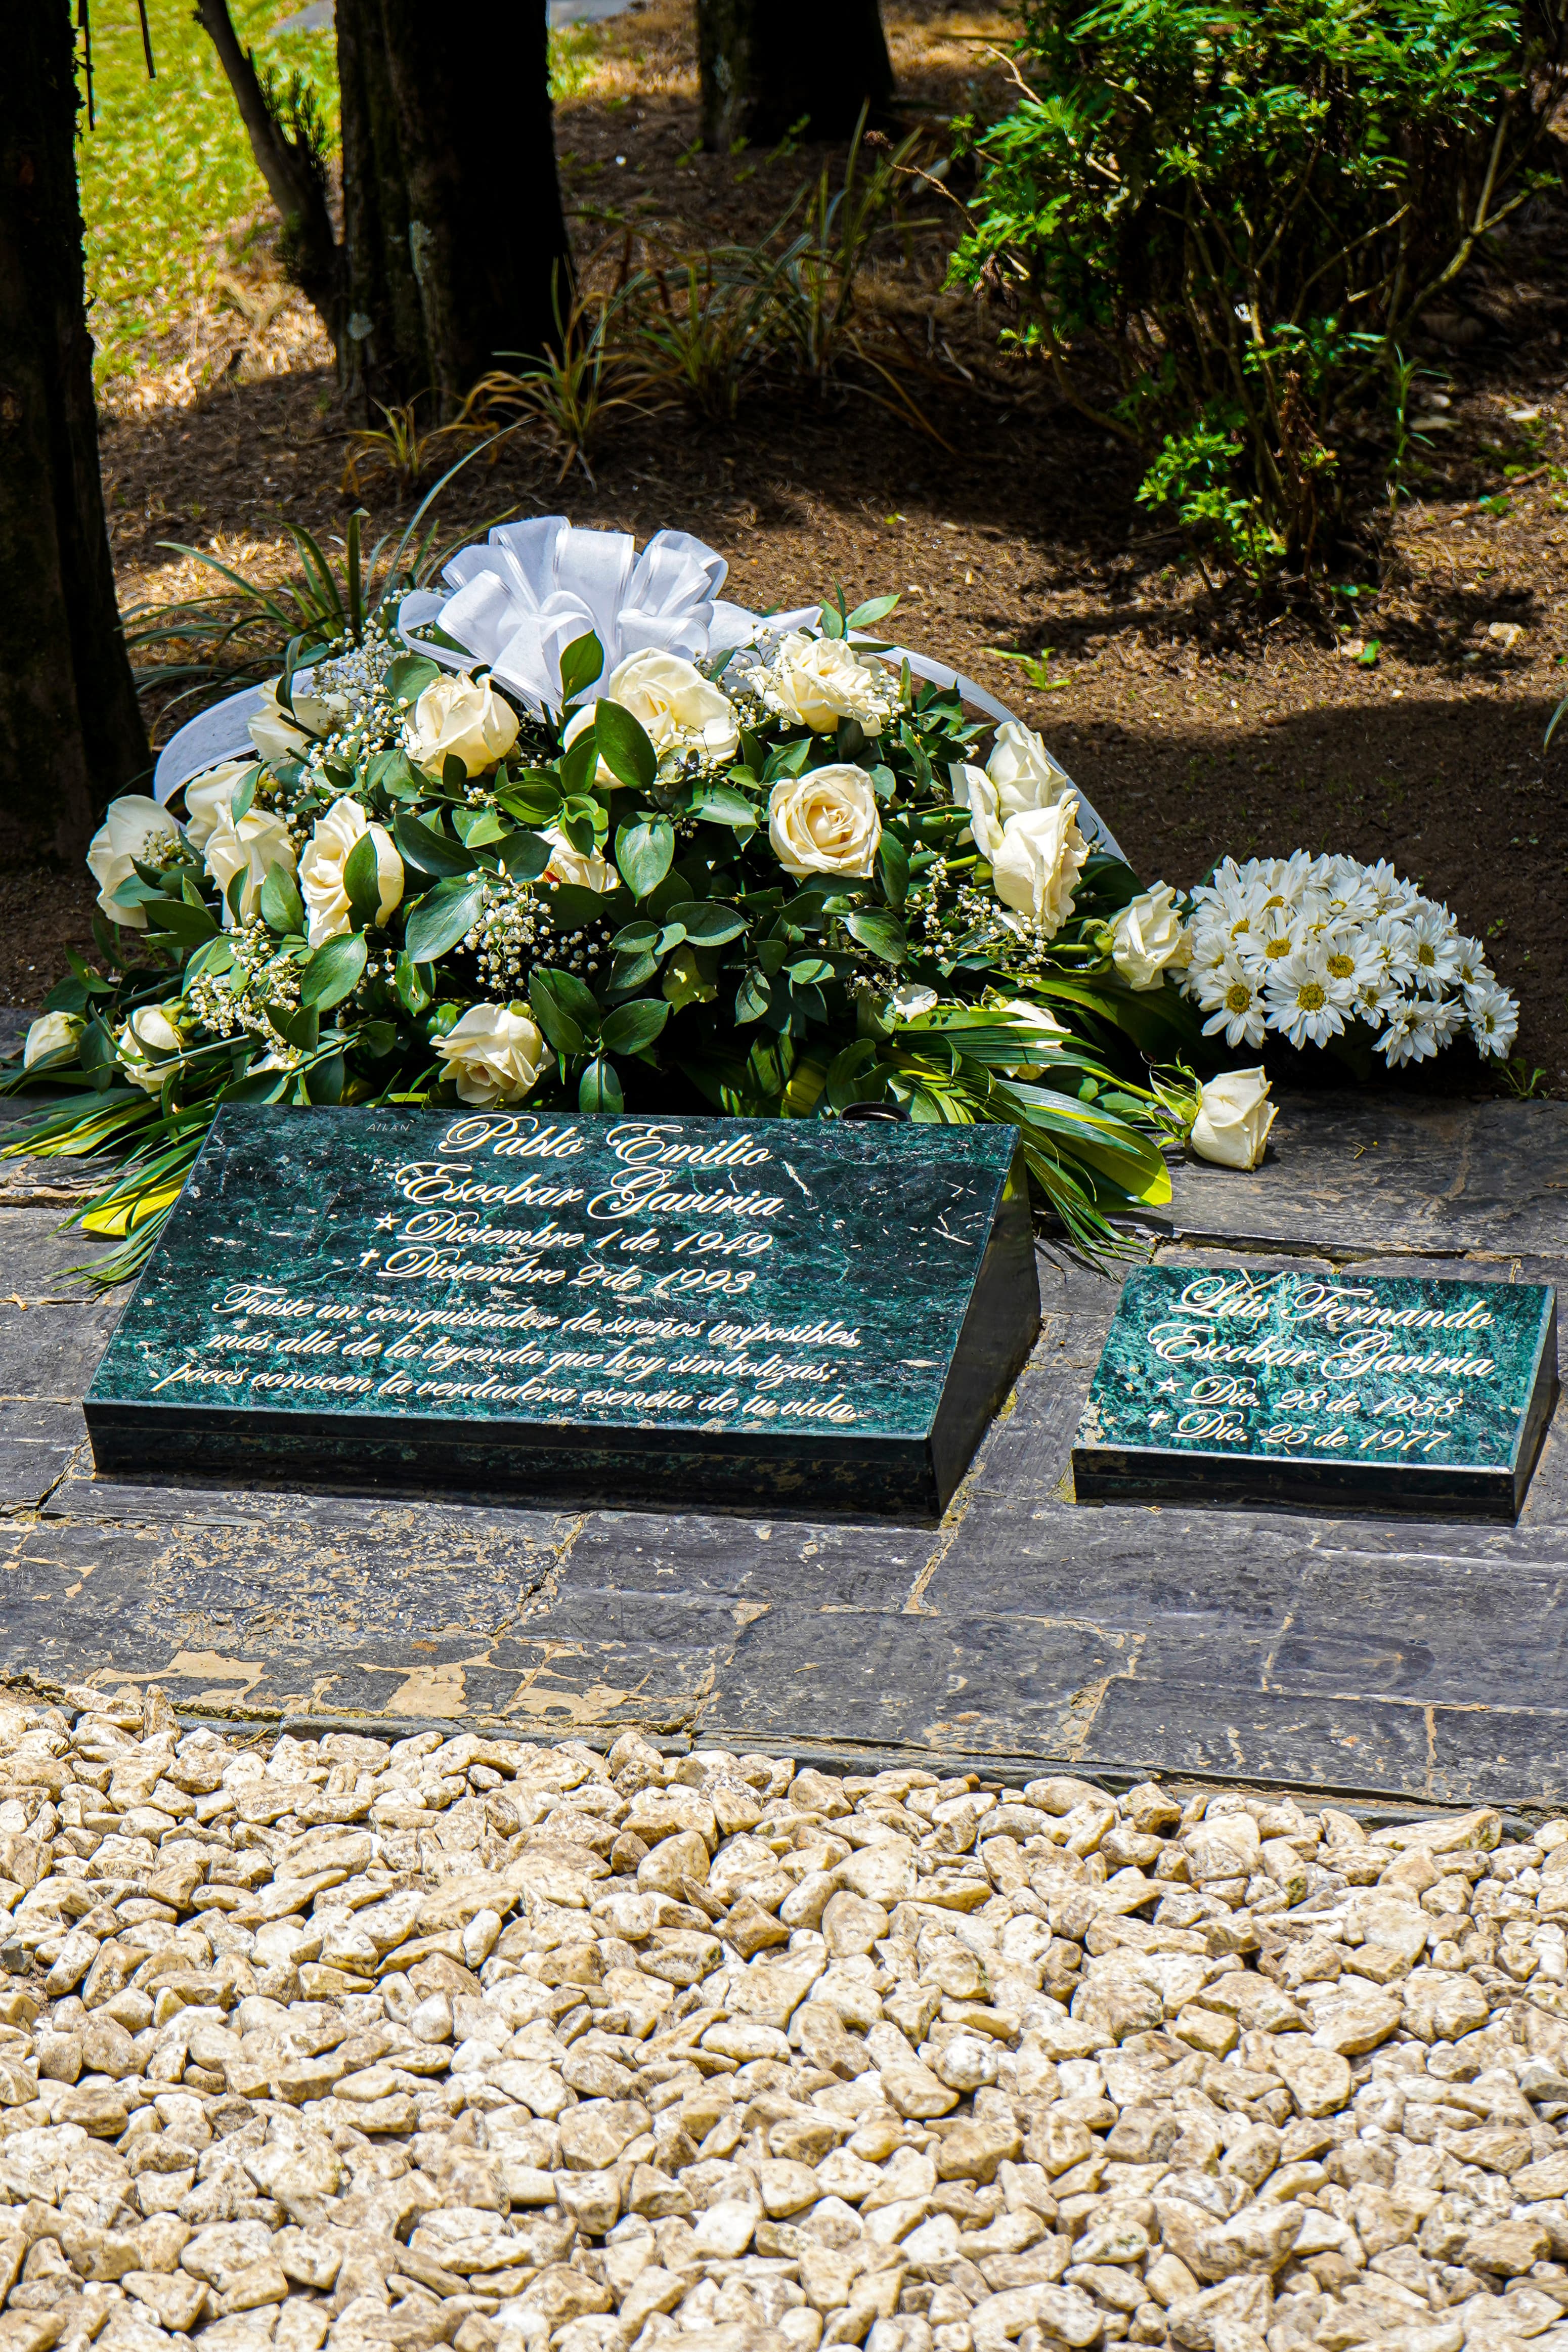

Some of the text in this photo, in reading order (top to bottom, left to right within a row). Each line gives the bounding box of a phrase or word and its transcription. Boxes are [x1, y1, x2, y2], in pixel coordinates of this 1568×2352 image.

[438, 1114, 773, 1166] Pablo Emilio
[395, 1162, 784, 1219] Escobar Gaviria
[397, 1210, 774, 1256] Diciembre 1 de 1949
[376, 1246, 757, 1294] Diciembre 2 de 1993
[212, 1283, 314, 1316] Fuiste
[316, 1305, 363, 1320] un
[365, 1306, 559, 1334] conquistador
[562, 1309, 602, 1332] de
[603, 1315, 706, 1337] sueños
[1168, 1276, 1496, 1329] Luis Fernando
[205, 1330, 272, 1352] más
[275, 1330, 344, 1356] allá
[342, 1333, 383, 1356] de
[383, 1334, 421, 1359] la
[422, 1336, 542, 1373] leyenda
[540, 1353, 605, 1376] que
[602, 1346, 666, 1383] hoy
[1147, 1322, 1496, 1380] Escobar Gaviria
[151, 1363, 858, 1419] pocos conocen la verdadera esencia de tu vida.
[1183, 1375, 1464, 1419] Dic. 28 de 1958
[1169, 1410, 1452, 1452] Dic. 25 de 1977
